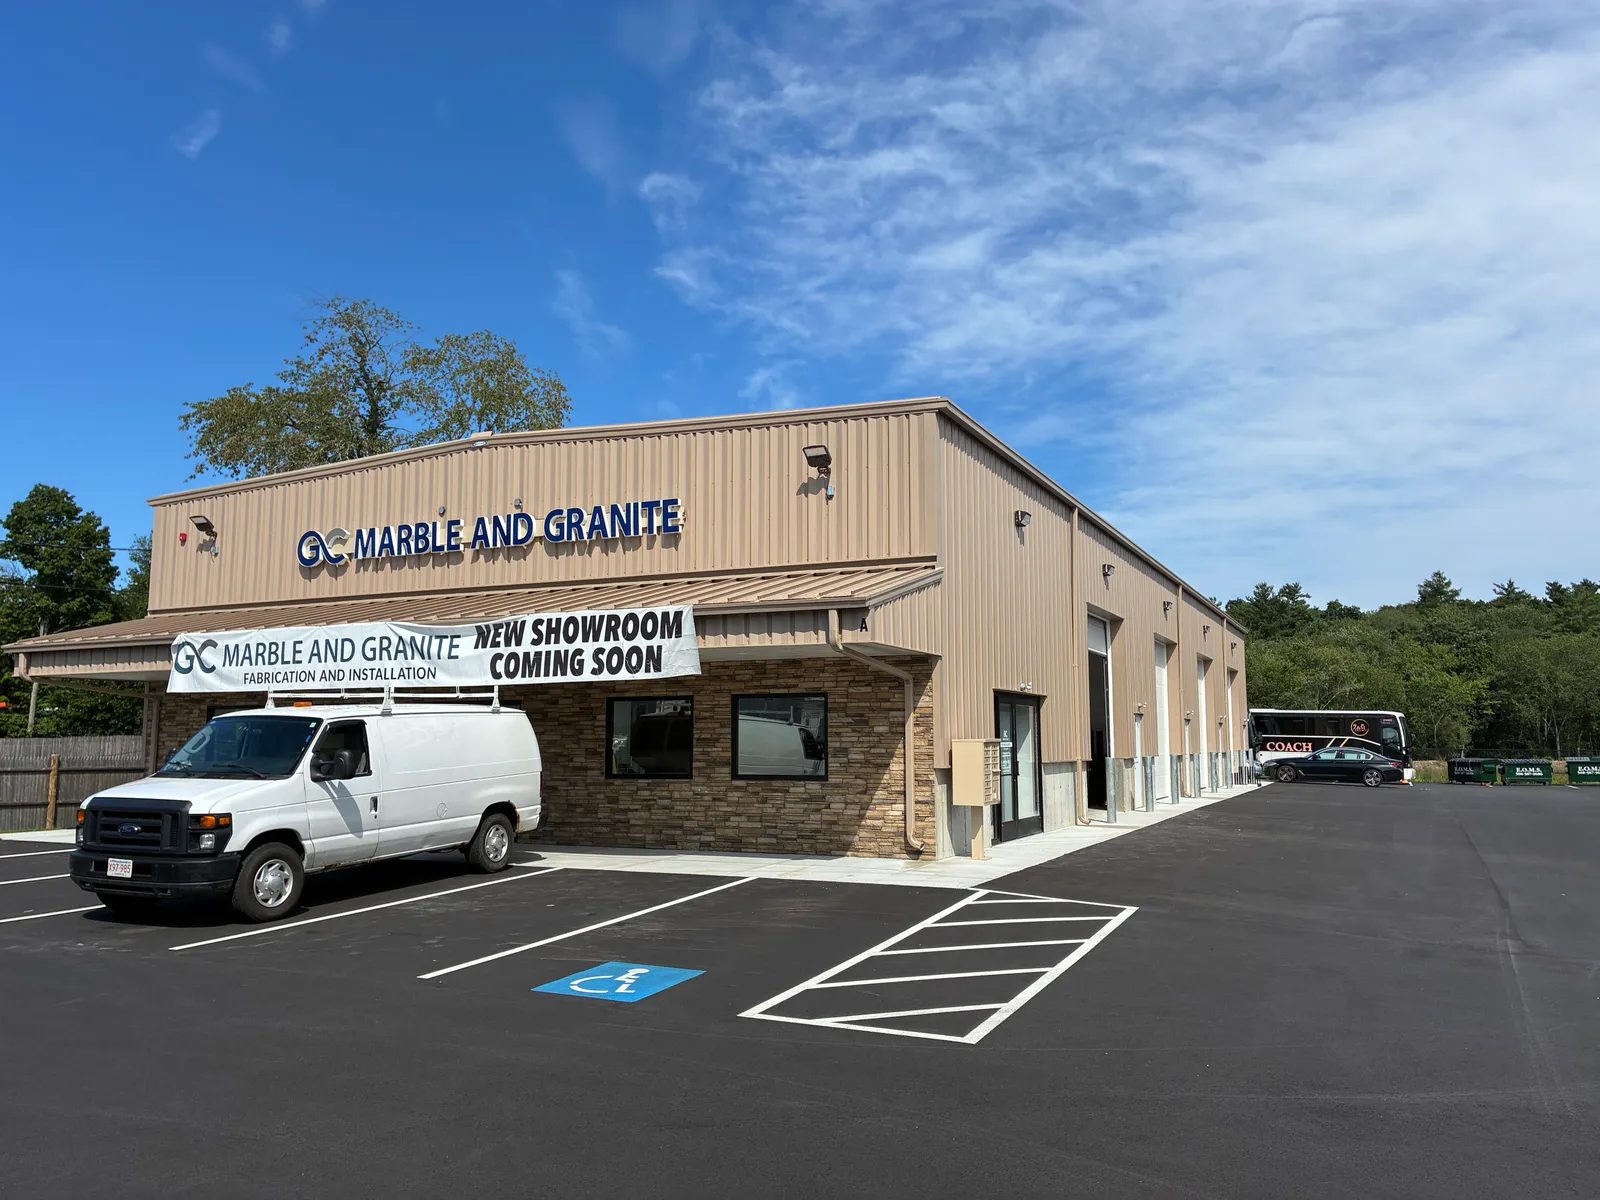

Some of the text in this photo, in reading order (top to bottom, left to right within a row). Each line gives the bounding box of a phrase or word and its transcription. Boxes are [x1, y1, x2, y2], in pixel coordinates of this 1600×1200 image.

[354, 519, 464, 560] MARBLE
[471, 511, 534, 550] AND
[543, 497, 682, 543] GRANITE
[474, 609, 684, 649] NEW SHOWROOM
[860, 618, 868, 632] A
[223, 638, 304, 666] MARBLE
[308, 638, 356, 664] AND
[362, 634, 461, 661] GRANITE
[489, 643, 663, 680] COMING SOON
[243, 666, 437, 685] FABRICATION AND INSTALLATION
[1266, 742, 1312, 752] COACH
